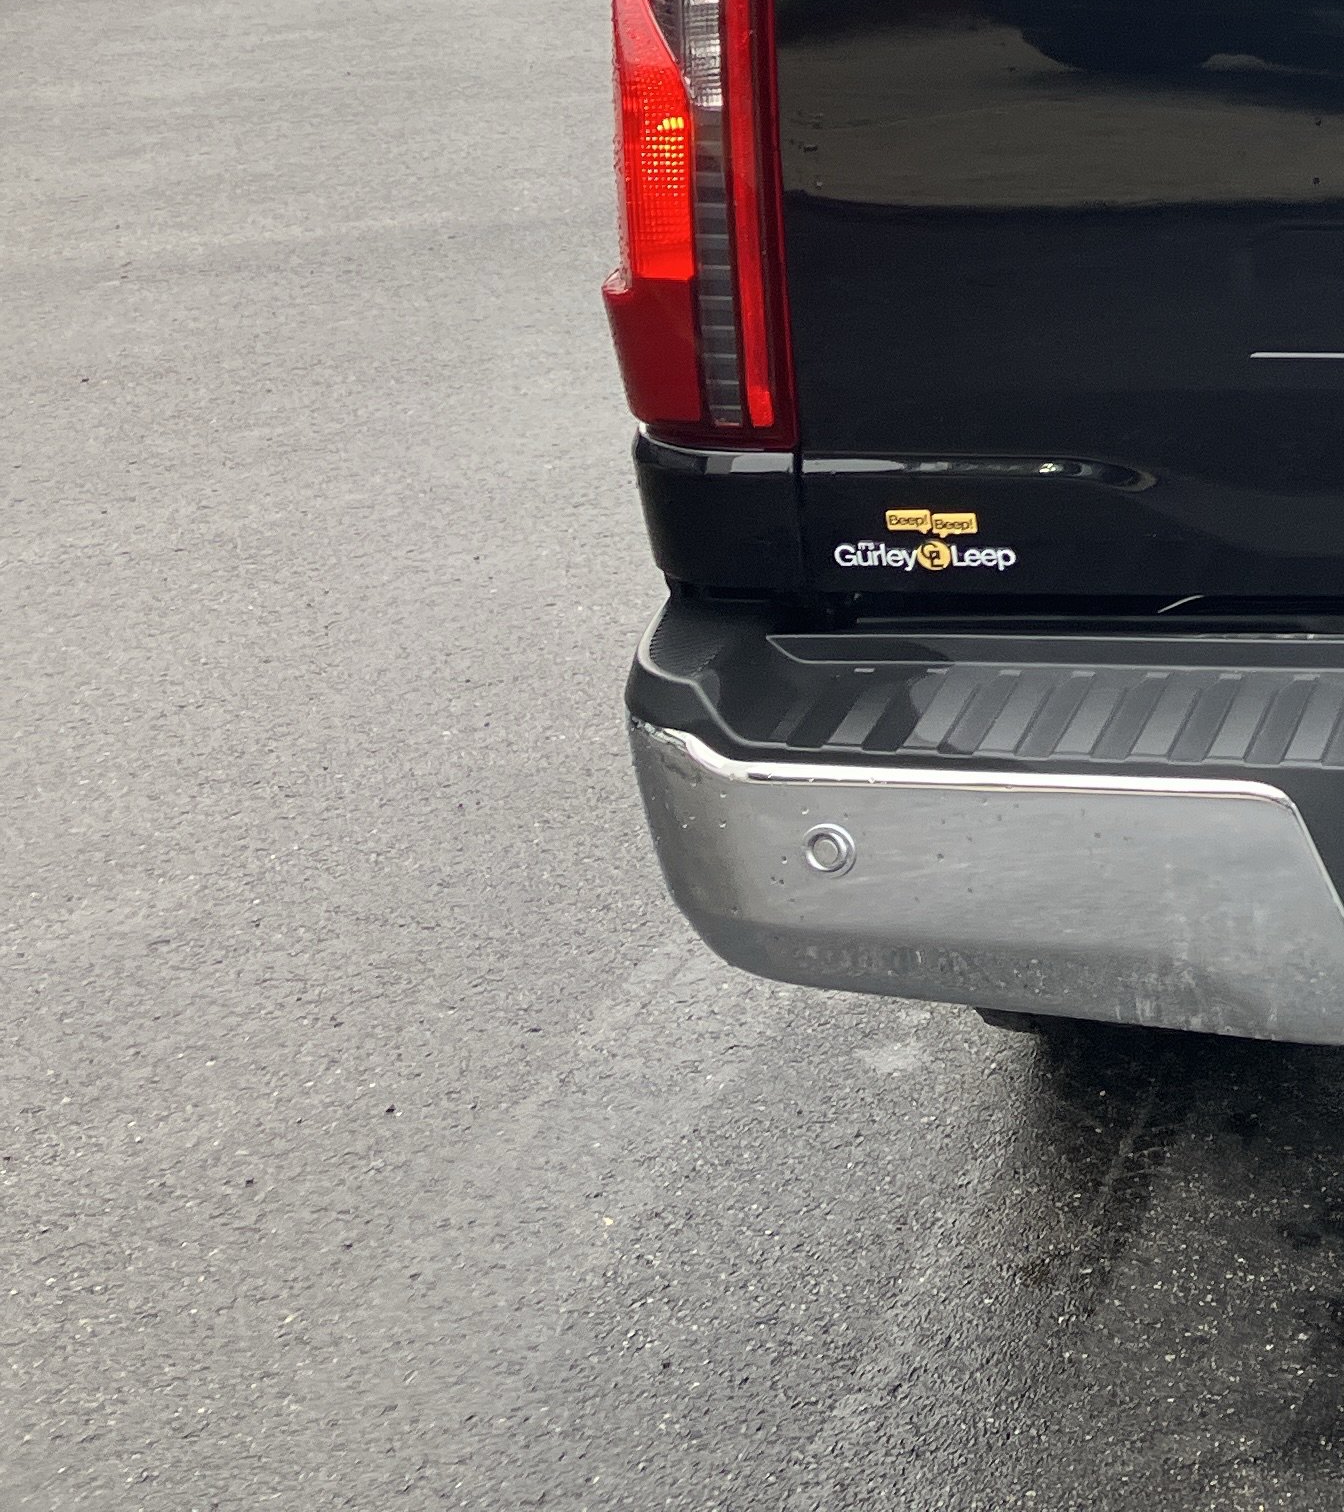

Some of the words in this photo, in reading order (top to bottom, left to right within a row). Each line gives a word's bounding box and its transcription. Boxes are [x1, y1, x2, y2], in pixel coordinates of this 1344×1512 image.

[888, 514, 928, 527] Beep!
[934, 518, 974, 531] Beep!
[951, 544, 1017, 571] Leep
